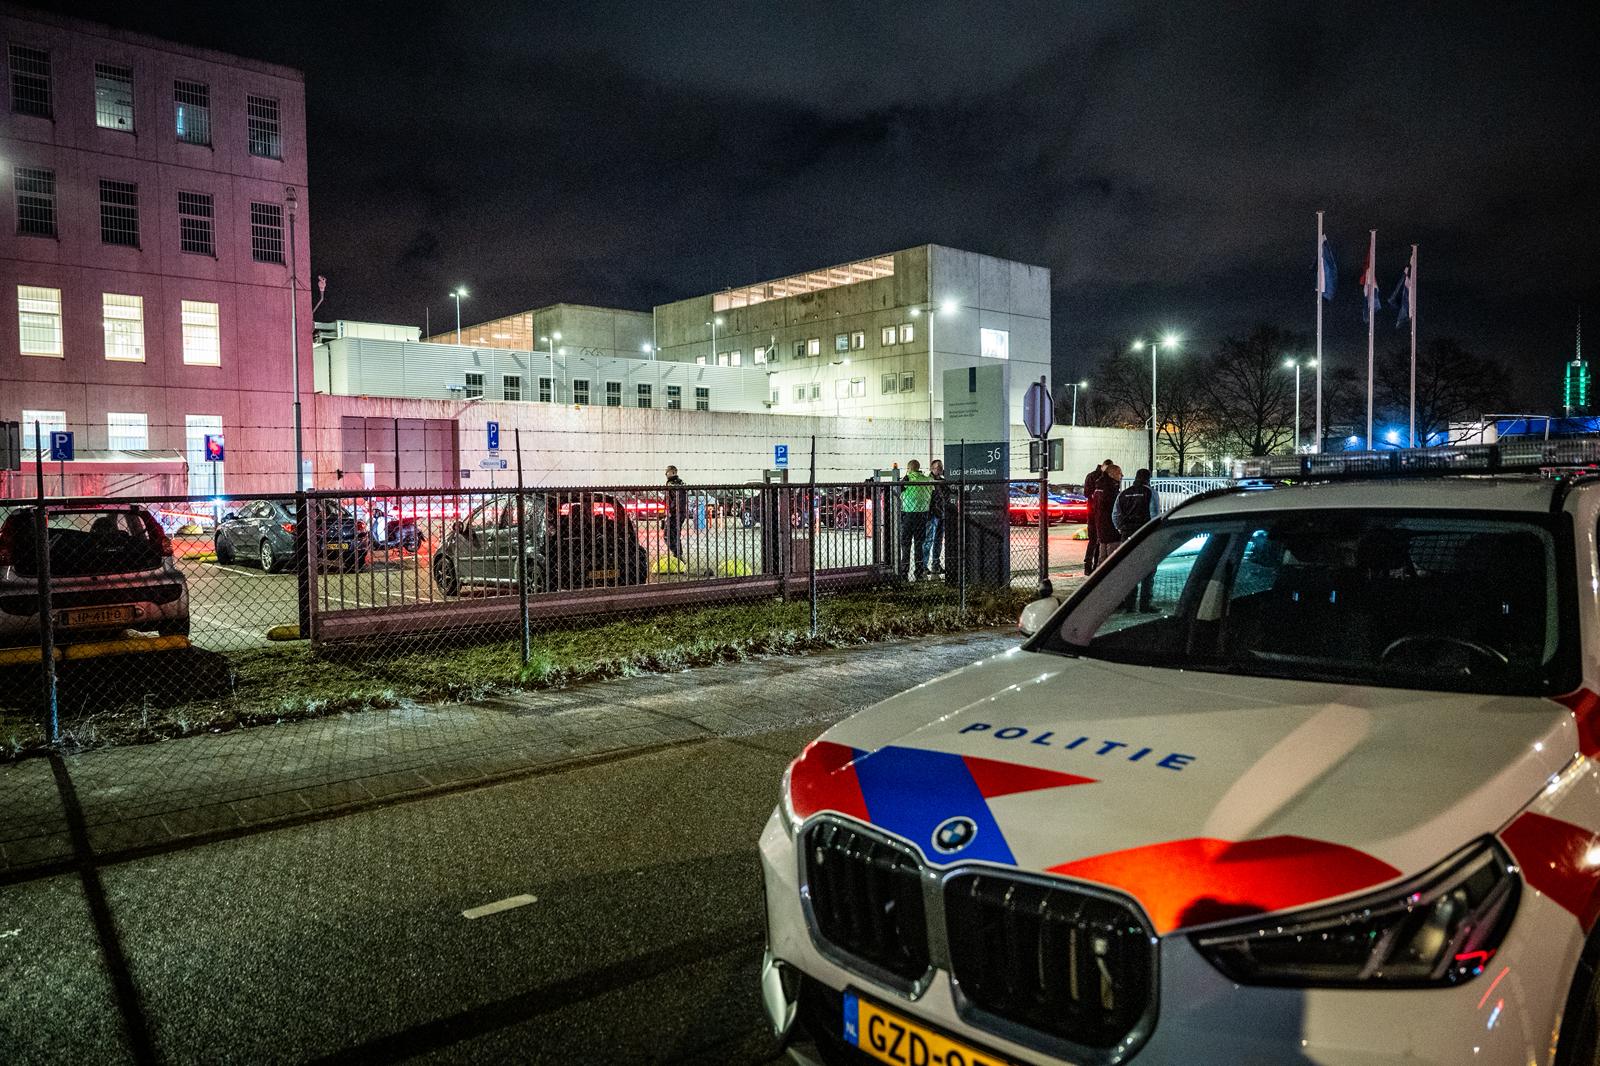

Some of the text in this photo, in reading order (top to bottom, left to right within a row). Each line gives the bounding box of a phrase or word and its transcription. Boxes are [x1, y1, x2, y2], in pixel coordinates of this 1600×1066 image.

[490, 424, 497, 438] P
[55, 434, 68, 449] P
[777, 446, 785, 457] P
[987, 447, 1001, 464] 36
[958, 722, 1197, 772] POLITIE
[845, 1022, 857, 1038] NL
